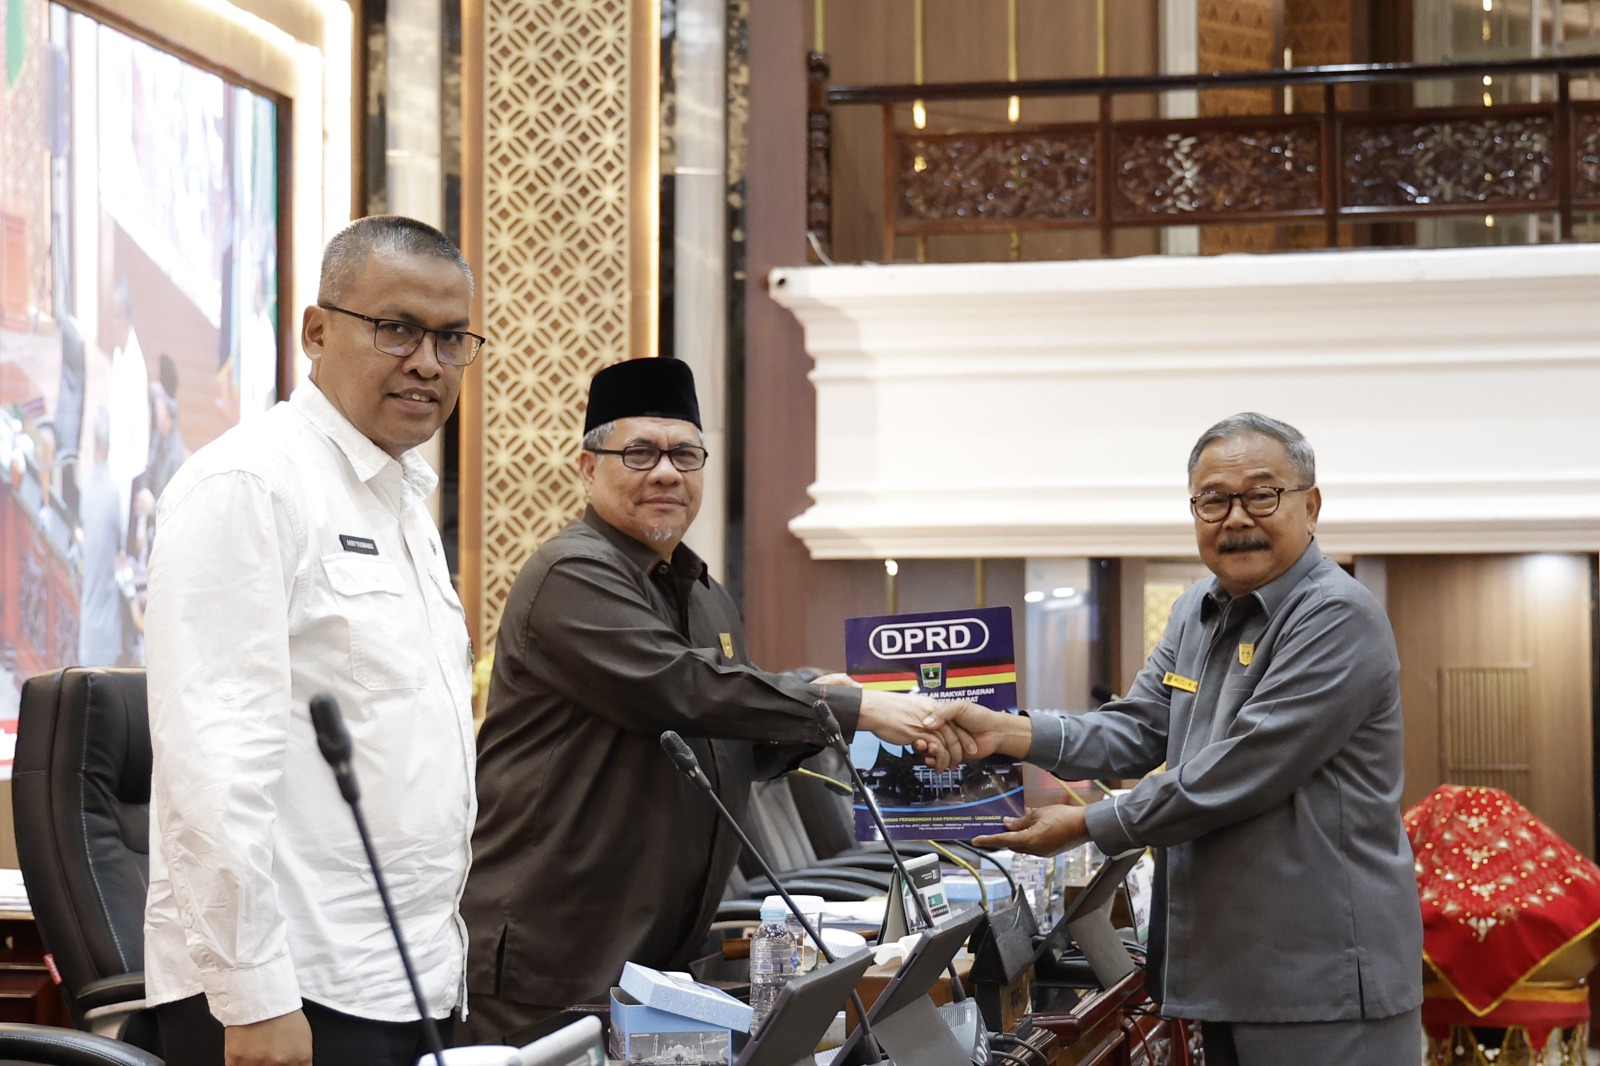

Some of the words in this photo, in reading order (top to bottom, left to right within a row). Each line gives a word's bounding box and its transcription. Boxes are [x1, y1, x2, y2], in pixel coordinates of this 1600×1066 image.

[881, 625, 971, 654] DPRD
[940, 690, 966, 698] RAKYAT
[967, 687, 995, 696] DAERAH
